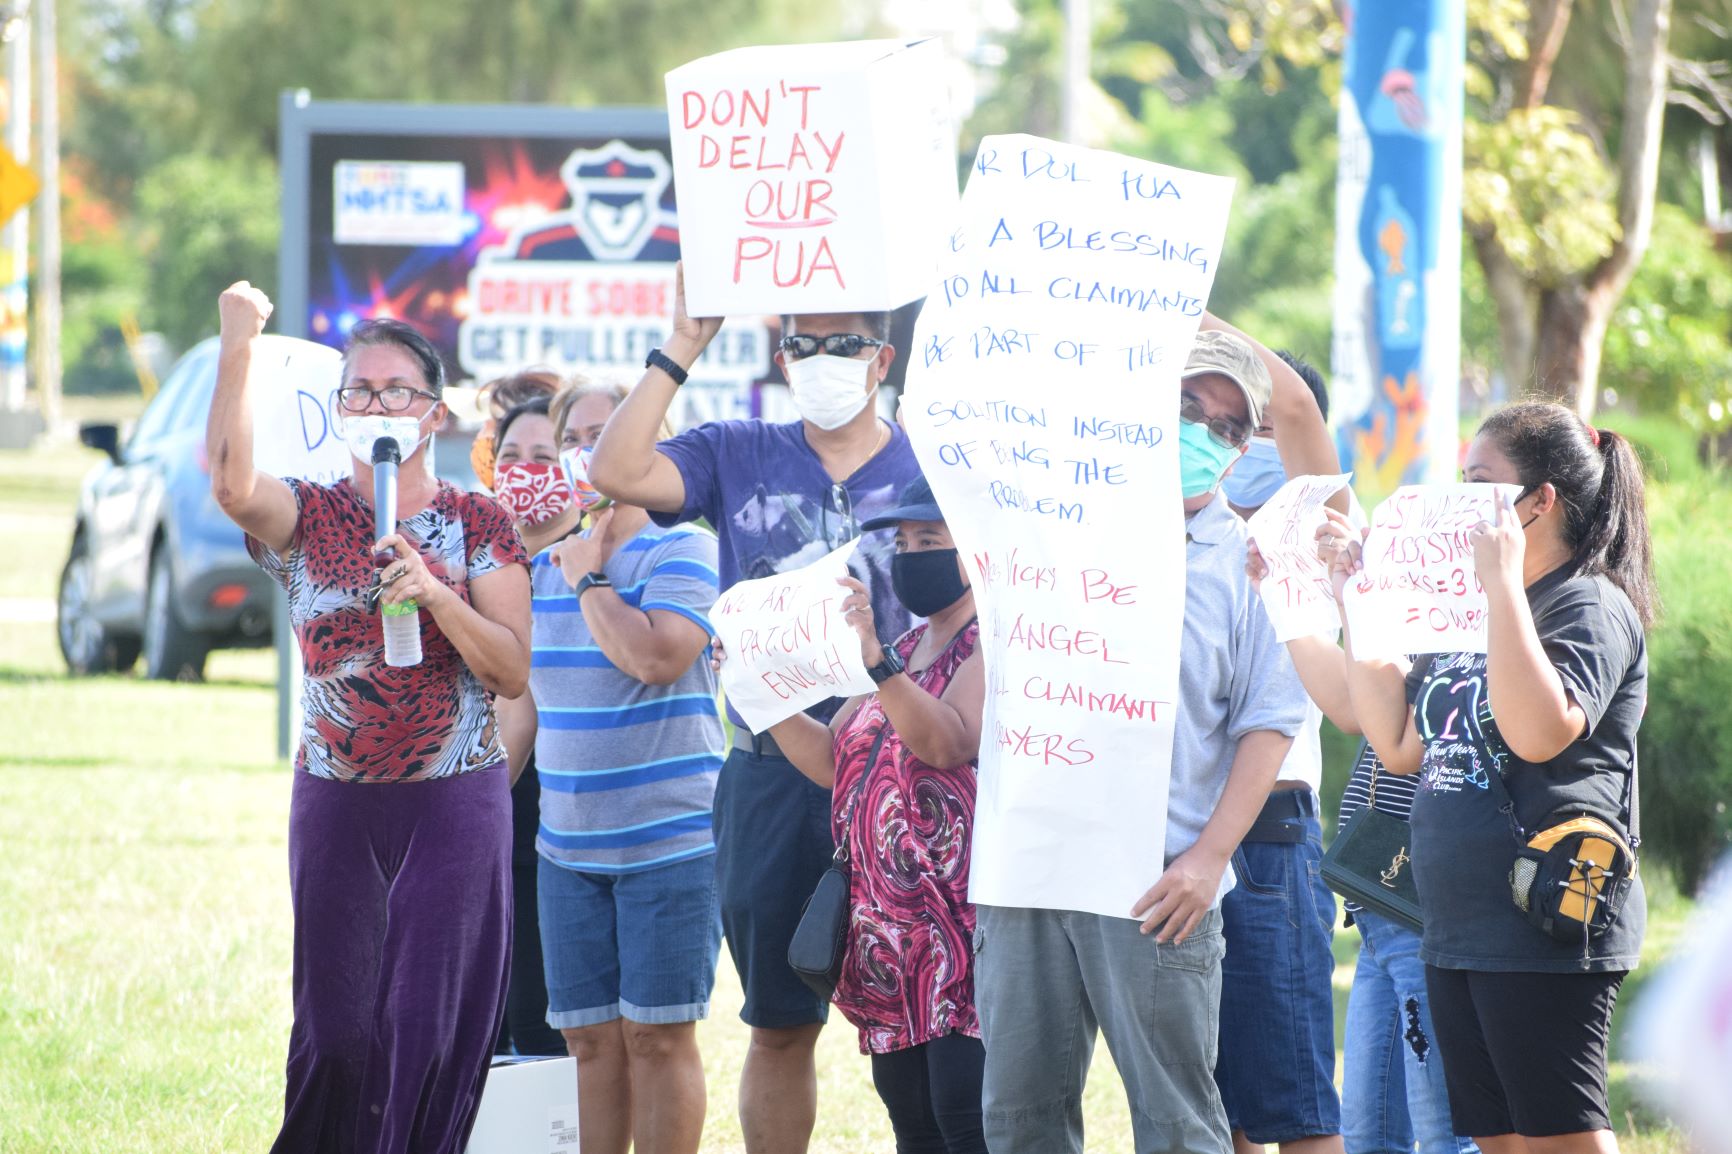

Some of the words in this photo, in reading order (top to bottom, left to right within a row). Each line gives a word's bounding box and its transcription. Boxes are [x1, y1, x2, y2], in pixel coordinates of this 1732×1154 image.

[682, 79, 821, 129] DON'T
[699, 131, 845, 173] DELAY
[745, 179, 838, 220] OUR
[733, 236, 846, 290] PUA
[988, 217, 1014, 248] A
[1033, 220, 1208, 274] BLESSING
[478, 279, 572, 315] DRIVE
[586, 282, 674, 316] SOBE
[981, 269, 1033, 298] ALL
[1048, 277, 1203, 317] CLAIMANTS
[470, 326, 528, 362] GET
[924, 334, 956, 369] BE
[970, 326, 1041, 360] PART
[1054, 340, 1103, 366] OF
[1119, 339, 1164, 372] THE
[1074, 416, 1163, 449] INSTEAD
[939, 441, 977, 470] OF
[1064, 457, 1128, 485] THE
[1081, 568, 1138, 605] BE
[1007, 613, 1131, 664] ANGEL
[1023, 676, 1172, 722] CLAIMANT
[1437, 773, 1465, 784] ISLANDS
